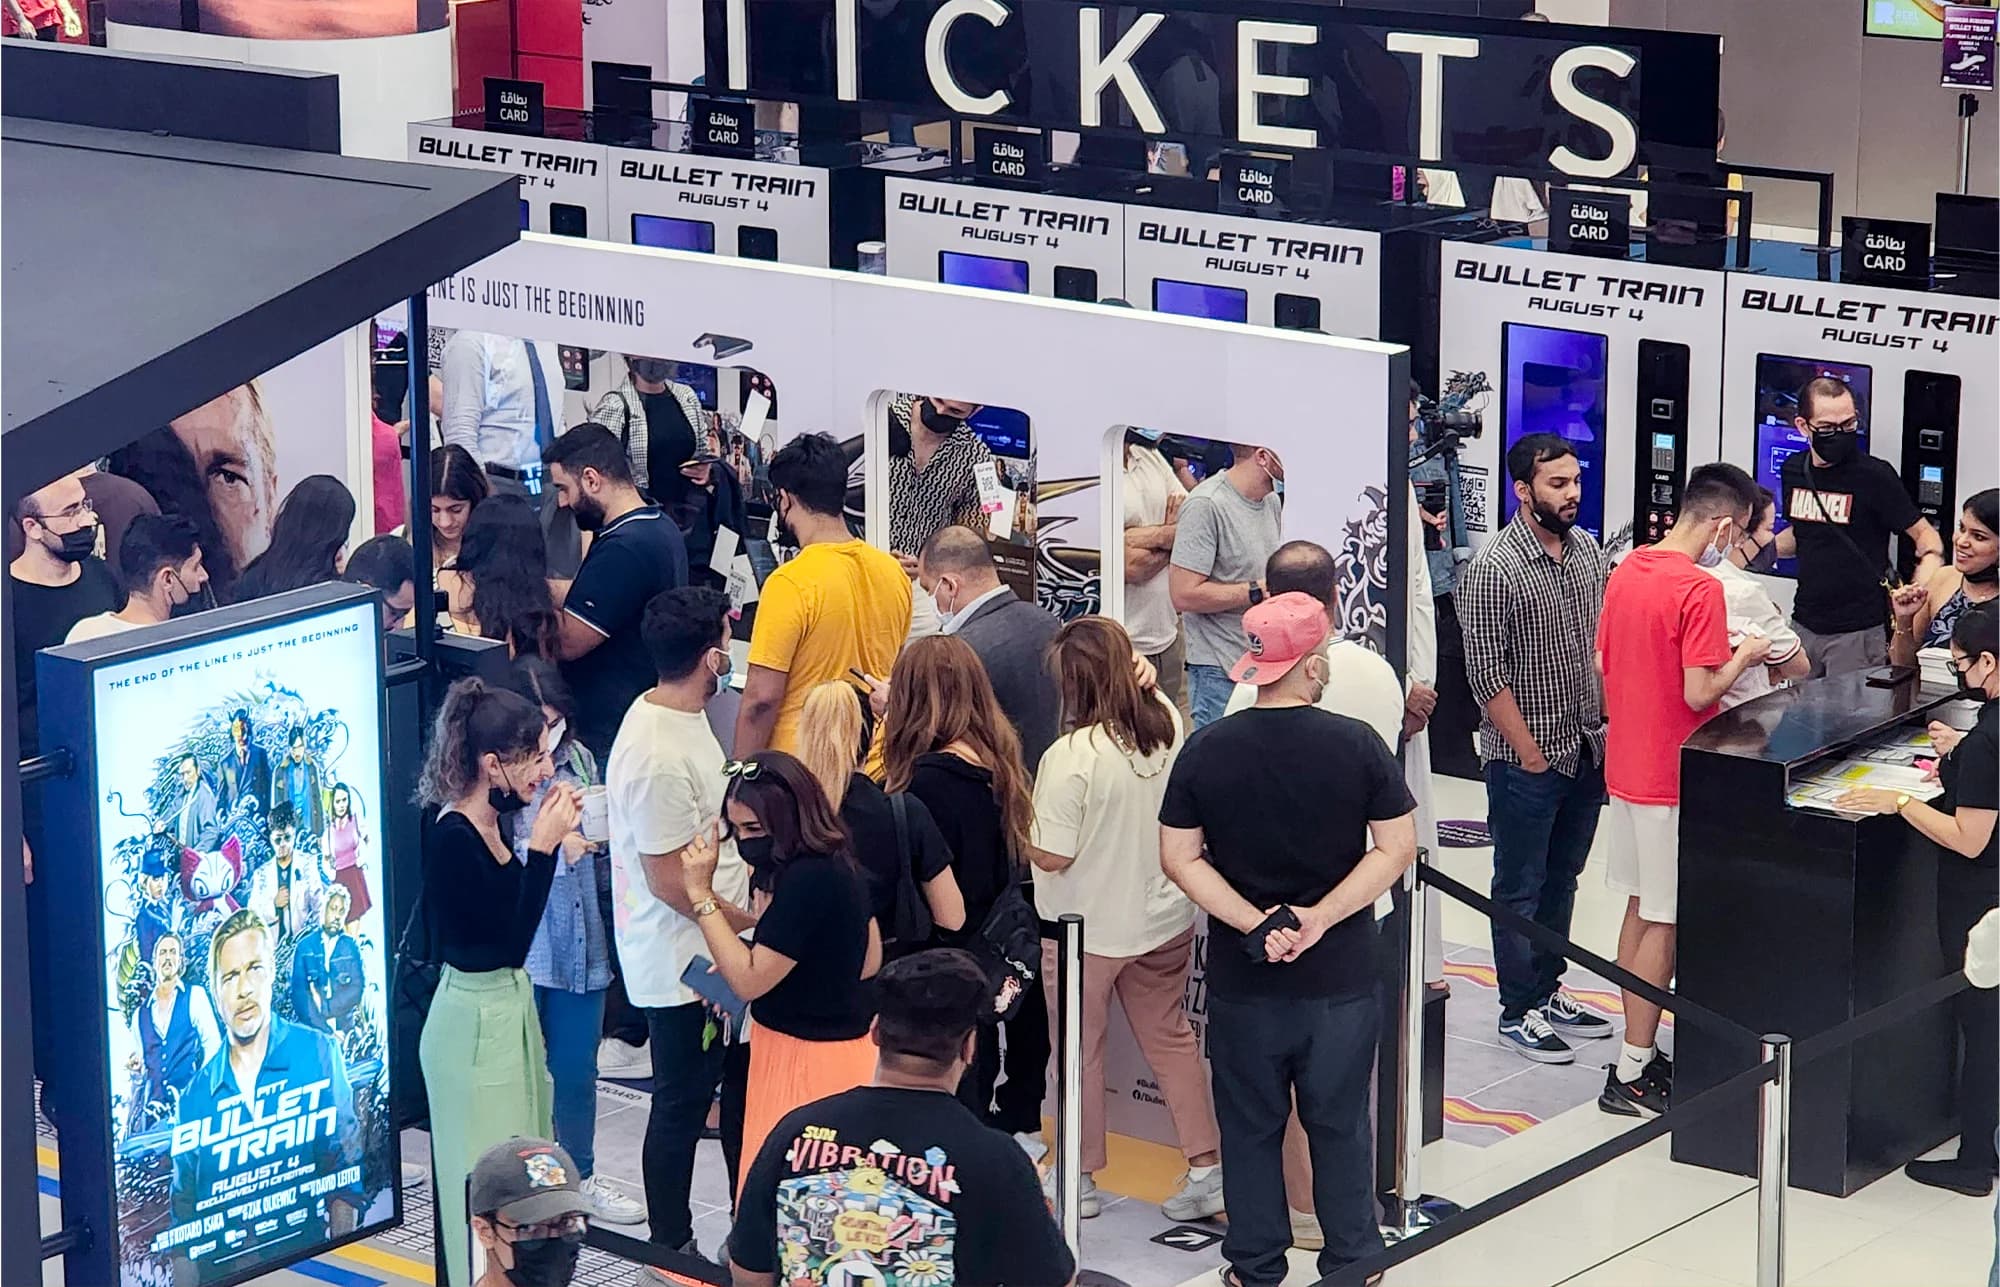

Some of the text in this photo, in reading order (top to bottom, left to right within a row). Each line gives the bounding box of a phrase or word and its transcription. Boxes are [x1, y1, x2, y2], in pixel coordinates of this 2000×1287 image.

[500, 91, 528, 108] بطاقة
[500, 107, 529, 122] CARD
[709, 113, 739, 130] بطاقة
[708, 129, 739, 144] CARD
[418, 137, 598, 176] BULLET TRAIN
[993, 143, 1024, 162] بطاقة
[620, 160, 815, 198] BULLET TRAIN
[992, 160, 1025, 176] CARD
[1239, 169, 1273, 189] بطاقة
[544, 178, 555, 189] 4
[679, 192, 768, 212] AUGUST 4
[1238, 187, 1274, 204] CARD
[899, 192, 1110, 235] BULLET TRAIN
[1571, 203, 1609, 225] بطاقة
[961, 226, 1059, 249] AUGUST 4
[1138, 222, 1364, 265] BULLET TRAIN
[1569, 223, 1609, 241] CARD
[1865, 233, 1906, 255] بطاقة
[1205, 257, 1310, 280] AUGUST 4
[1864, 254, 1906, 272] CARD
[1454, 259, 1705, 307] BULLET TRAIN
[461, 276, 475, 303] IS
[482, 279, 519, 310] JUST
[525, 285, 551, 314] THE
[558, 290, 645, 327] BEGINNING
[1528, 297, 1645, 321] AUGUST 4
[1742, 289, 1886, 323] BULLET
[1822, 328, 1948, 353] AUGUST 4
[1790, 488, 1850, 524] MARVEL
[109, 623, 359, 690] THE END OF THE LINE IS JUST THE BEGINNING
[170, 1078, 331, 1158] BULLET
[211, 1106, 337, 1172] TRAIN
[802, 1125, 838, 1141] SUN
[211, 1160, 284, 1196] AUGUST
[287, 1155, 300, 1170] 4
[791, 1137, 955, 1203] VIBRATION
